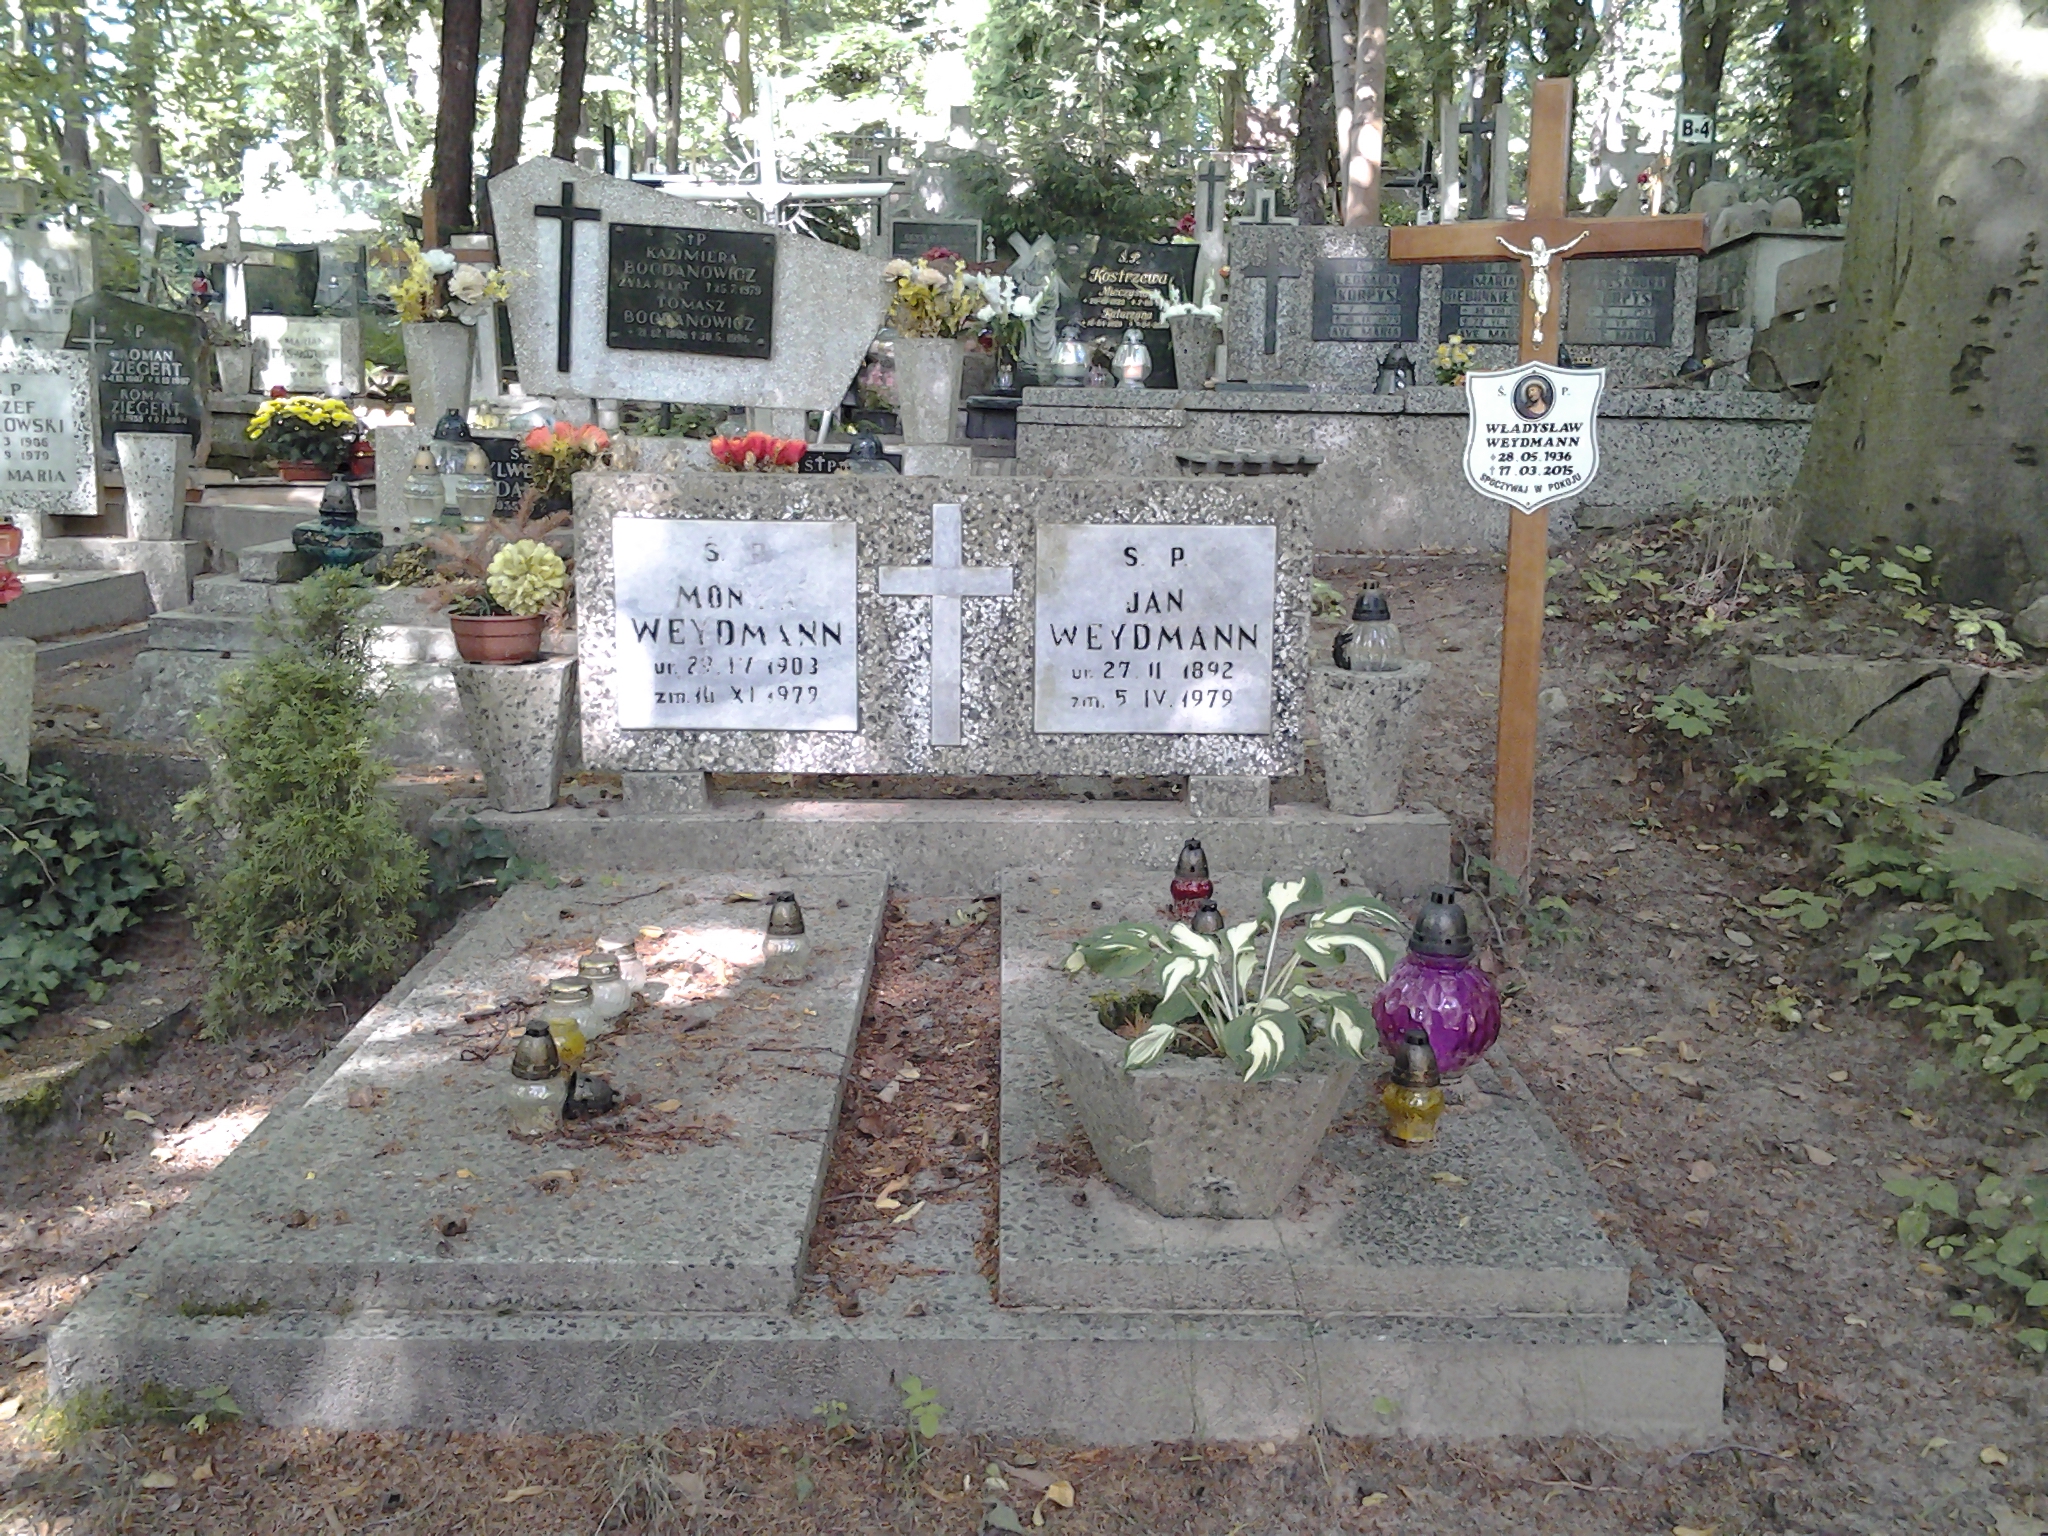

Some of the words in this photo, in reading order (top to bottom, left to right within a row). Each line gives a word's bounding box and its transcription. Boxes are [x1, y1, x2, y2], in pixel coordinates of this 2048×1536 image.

[624, 260, 757, 282] BOGDANOWICZ
[1088, 266, 1168, 284] Kostrzewa
[657, 295, 726, 312] TOMASZ
[624, 310, 755, 332] BOGDANOWICZ
[135, 324, 145, 338] P
[110, 361, 183, 377] ZIEGERT
[11, 383, 22, 396] P
[111, 400, 180, 416] ZIEGERT
[0, 418, 64, 433] OWSKI
[1486, 437, 1580, 449] WEYDMANN
[20, 450, 50, 461] 1979
[827, 460, 837, 472] P
[7, 469, 66, 483] MARIA
[1480, 472, 1529, 494] SPOCZYWAJ
[1534, 485, 1543, 494] W
[1548, 473, 1582, 492] POKOJU
[1126, 589, 1184, 614] JAN
[631, 618, 842, 647] WEYDMANN
[1050, 623, 1259, 651] WEYDMANN
[767, 656, 819, 675] 1903
[1182, 661, 1234, 680] 1892
[1114, 689, 1128, 707] 5
[1181, 689, 1234, 708] 1979
